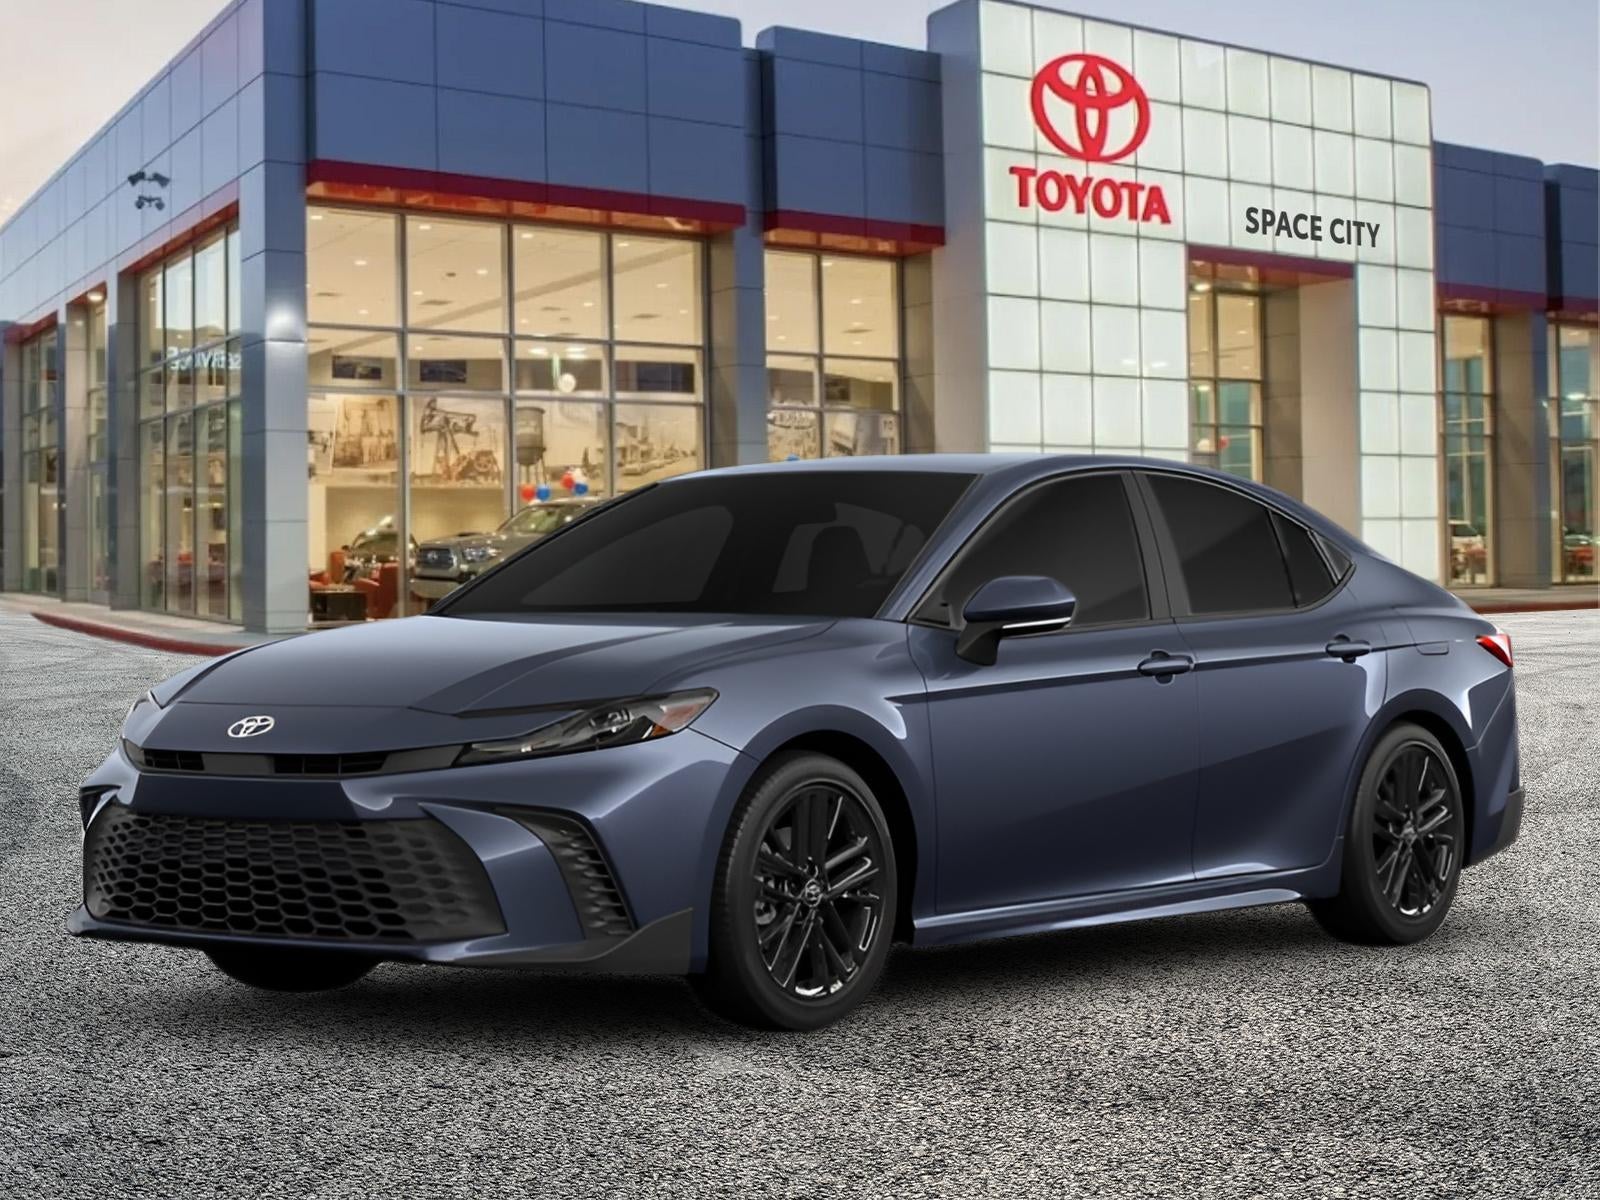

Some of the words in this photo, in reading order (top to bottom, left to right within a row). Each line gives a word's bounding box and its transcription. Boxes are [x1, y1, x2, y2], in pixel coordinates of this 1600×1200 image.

[1009, 166, 1171, 224] TOYOTA
[1245, 206, 1323, 242] SPACE
[1329, 218, 1381, 248] CITY
